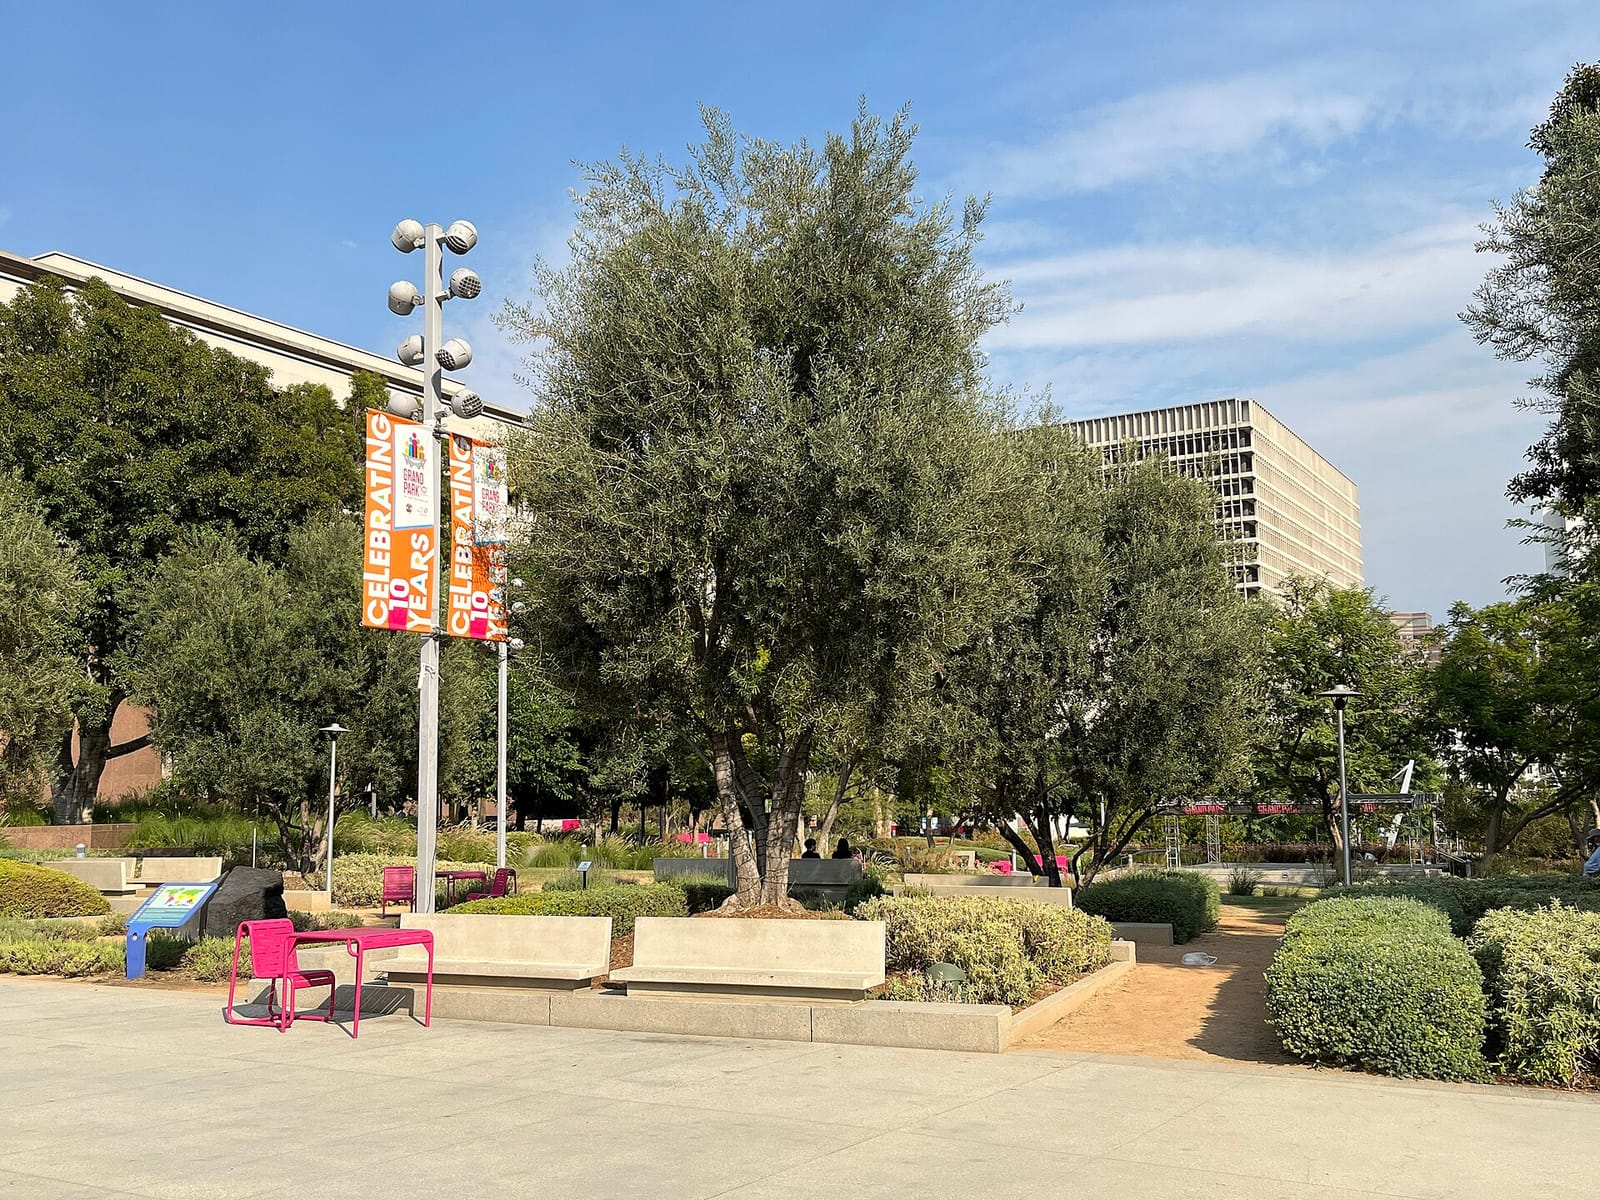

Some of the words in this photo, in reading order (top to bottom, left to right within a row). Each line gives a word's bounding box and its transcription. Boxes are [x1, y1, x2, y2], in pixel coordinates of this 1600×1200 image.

[403, 468, 424, 485] GRAND
[403, 481, 420, 497] PARK
[363, 413, 391, 626] CELEBRATING
[450, 437, 473, 635] CELEBRATING
[389, 578, 409, 612] 10
[406, 533, 434, 631] YEARS
[470, 591, 488, 621] 10
